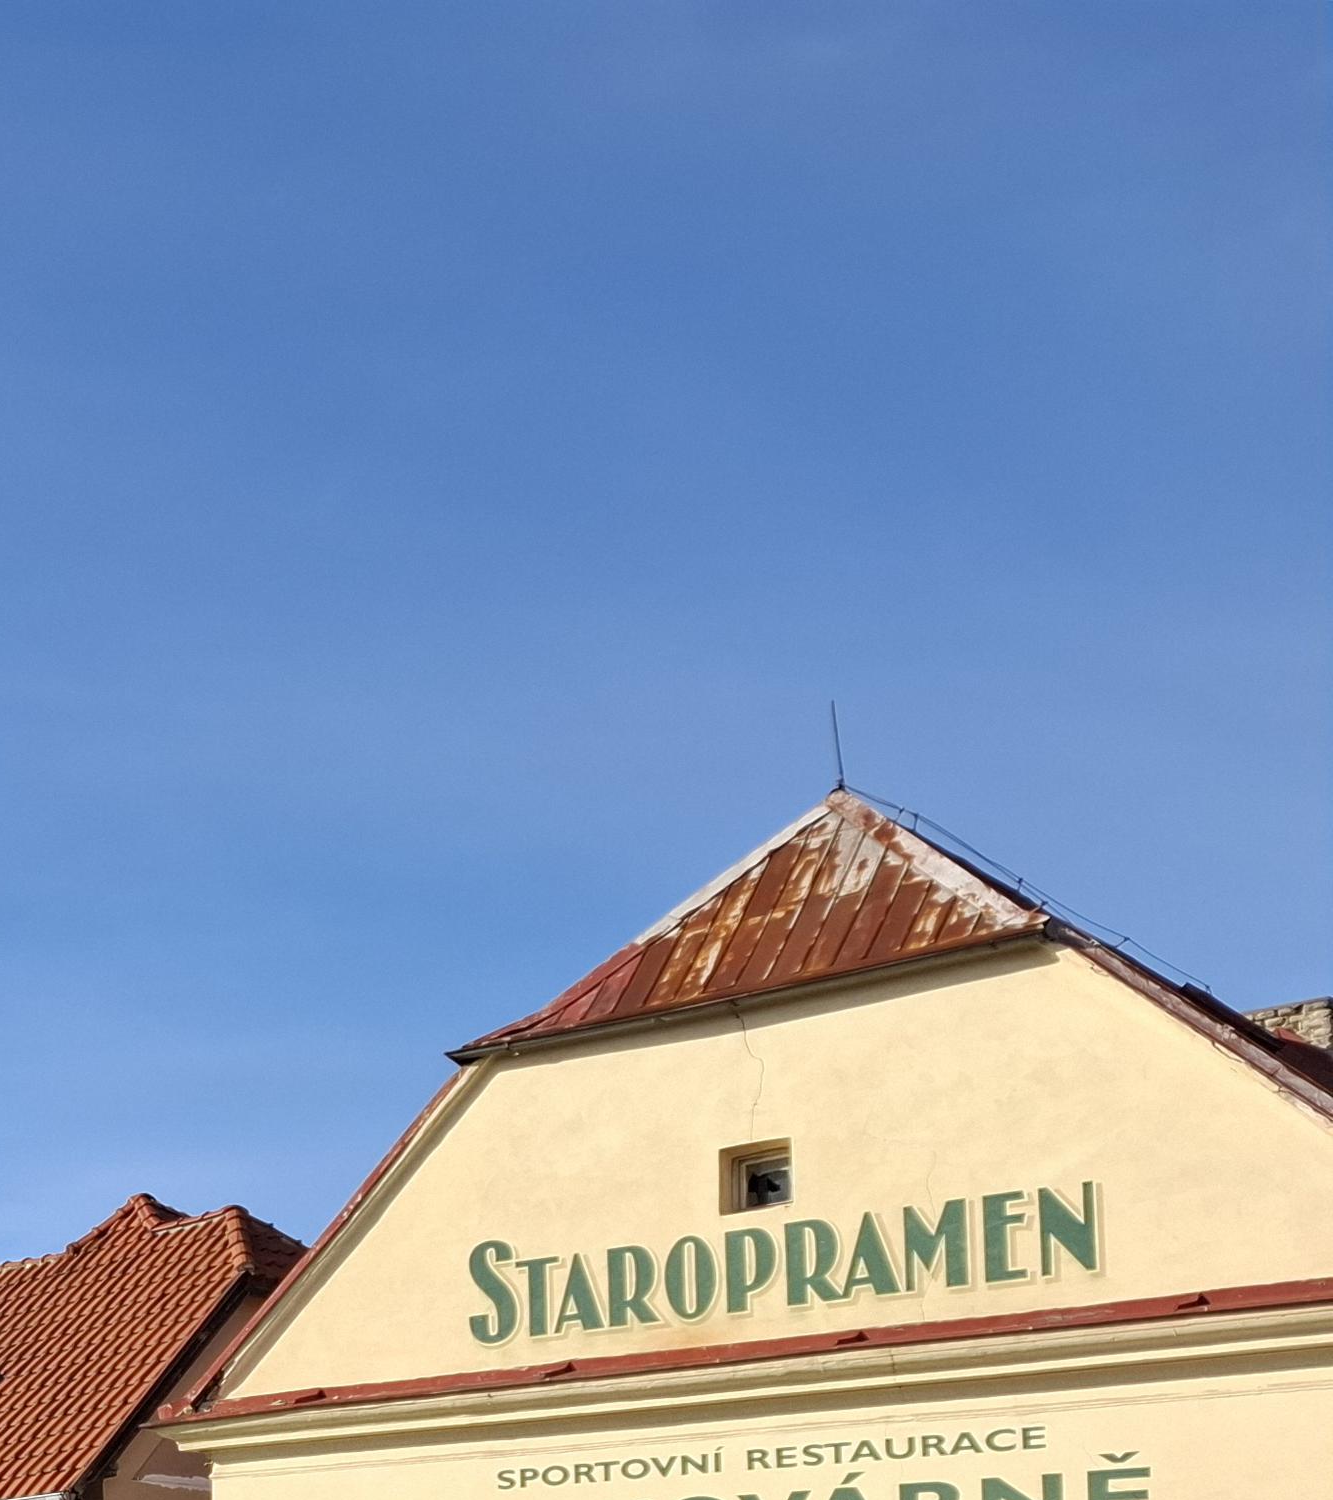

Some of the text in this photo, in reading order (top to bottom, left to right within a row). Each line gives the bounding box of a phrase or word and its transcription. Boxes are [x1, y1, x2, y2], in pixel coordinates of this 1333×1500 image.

[467, 1180, 1101, 1346] STAROPRAMEN
[495, 1425, 1049, 1490] SPORTOVNÍ RESTAURACE
